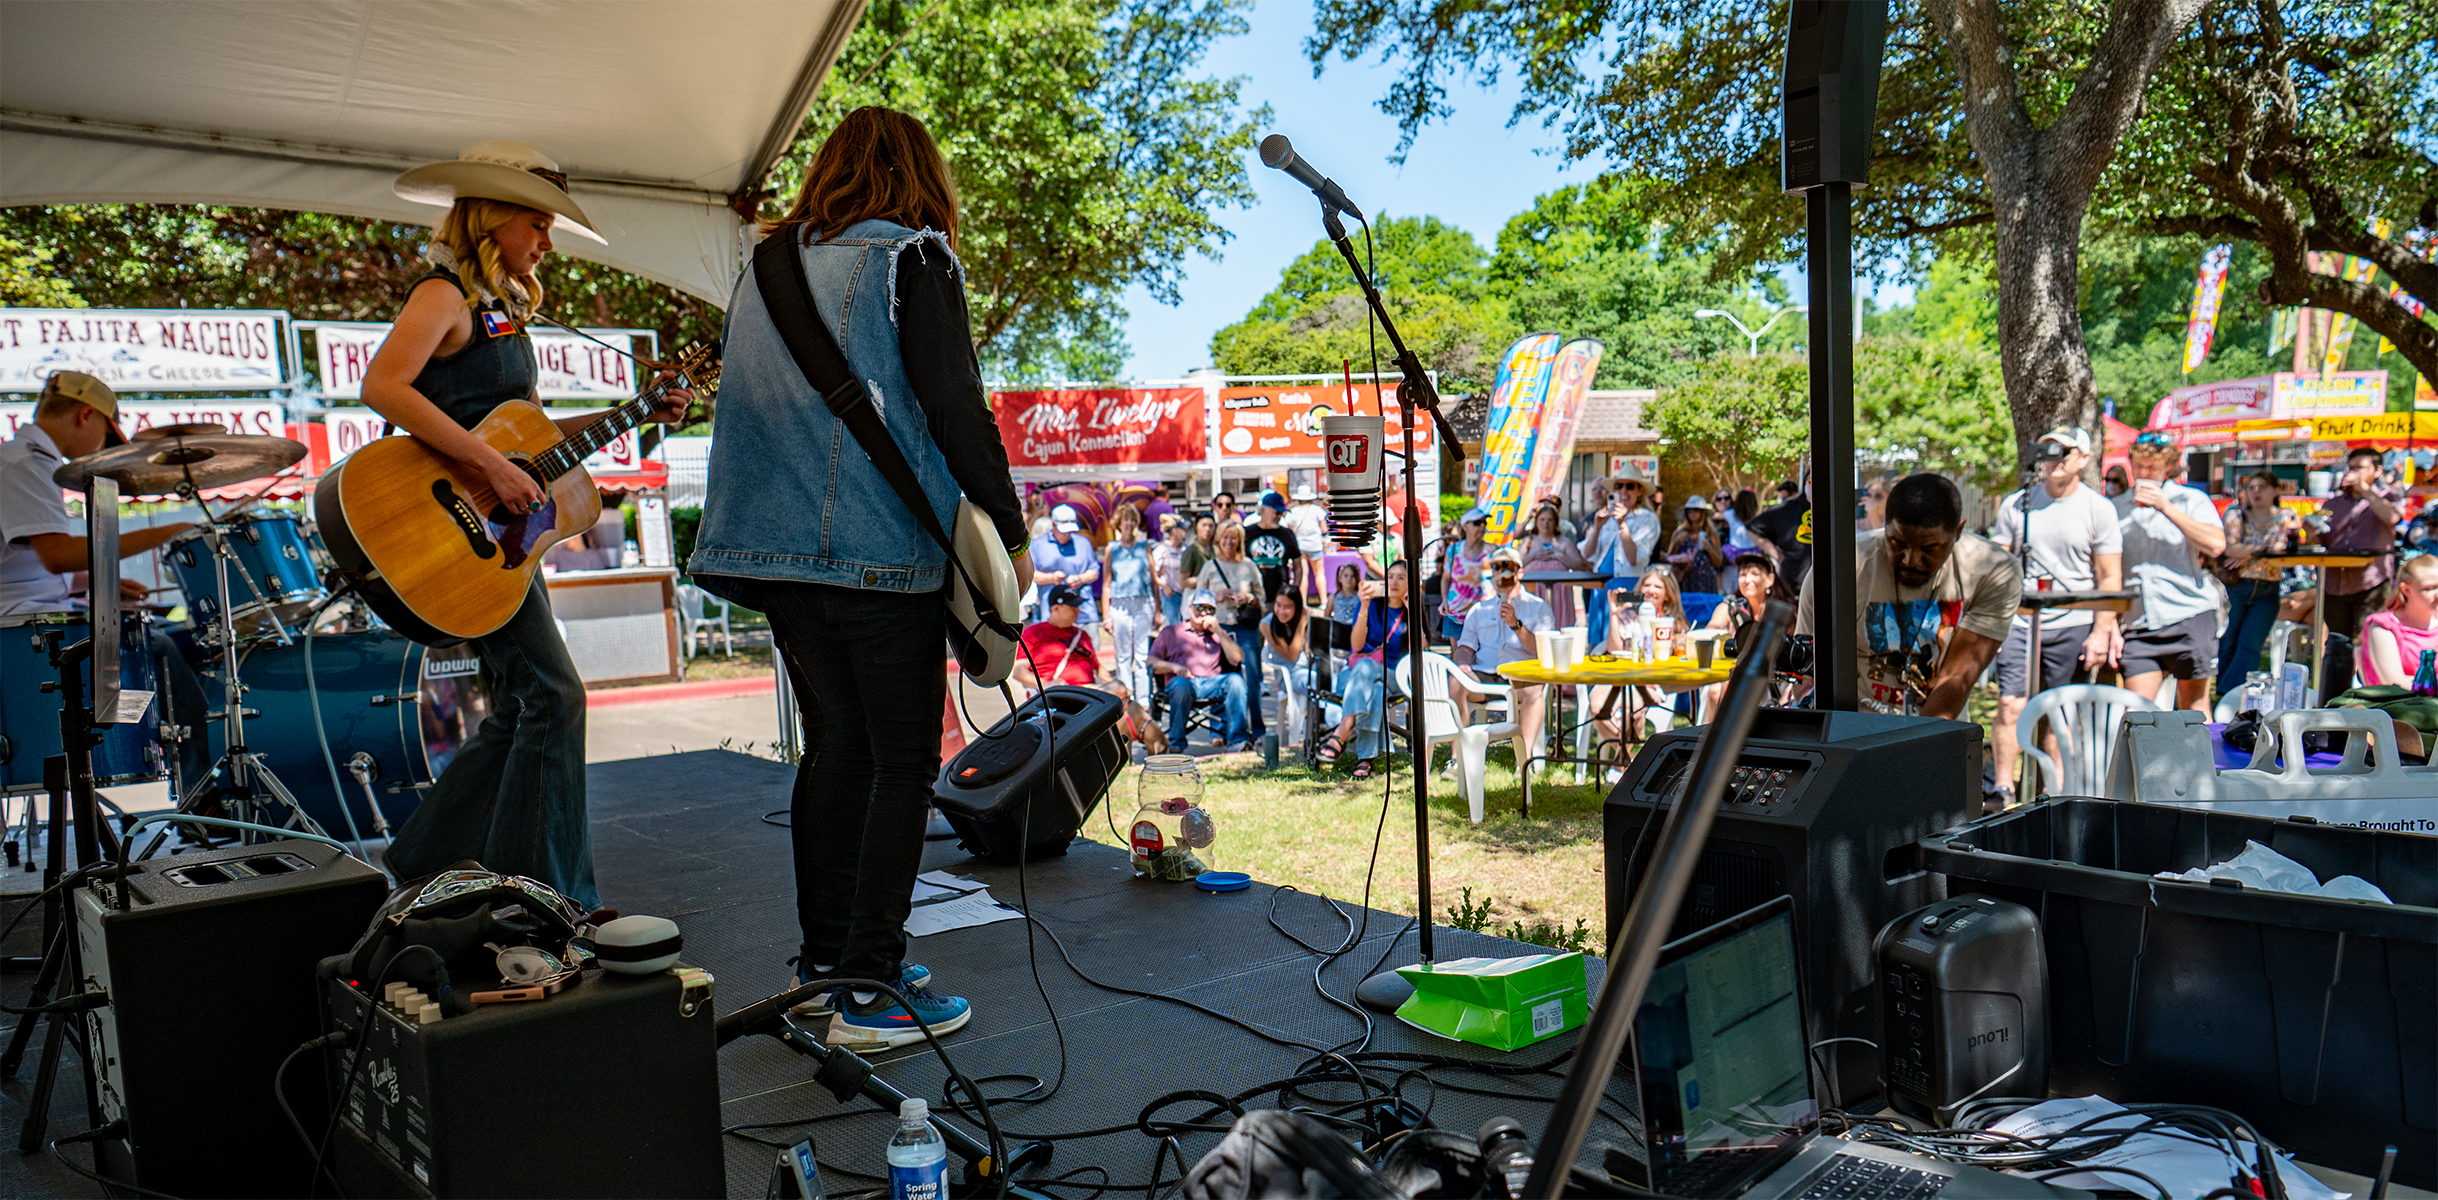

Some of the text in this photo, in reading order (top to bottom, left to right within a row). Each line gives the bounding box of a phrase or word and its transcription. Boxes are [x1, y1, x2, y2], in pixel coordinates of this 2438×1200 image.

[38, 319, 145, 345] FAJITA
[159, 320, 269, 360] NACHOS
[582, 344, 628, 391] TEA
[2318, 418, 2416, 437] Fruit Drinks
[1023, 436, 1066, 464] Cajun
[1328, 439, 1363, 469] QT
[2417, 819, 2436, 831] To
[1968, 1027, 2009, 1052] iLoud
[905, 1182, 938, 1194] Spring
[907, 1191, 937, 1200] Water
